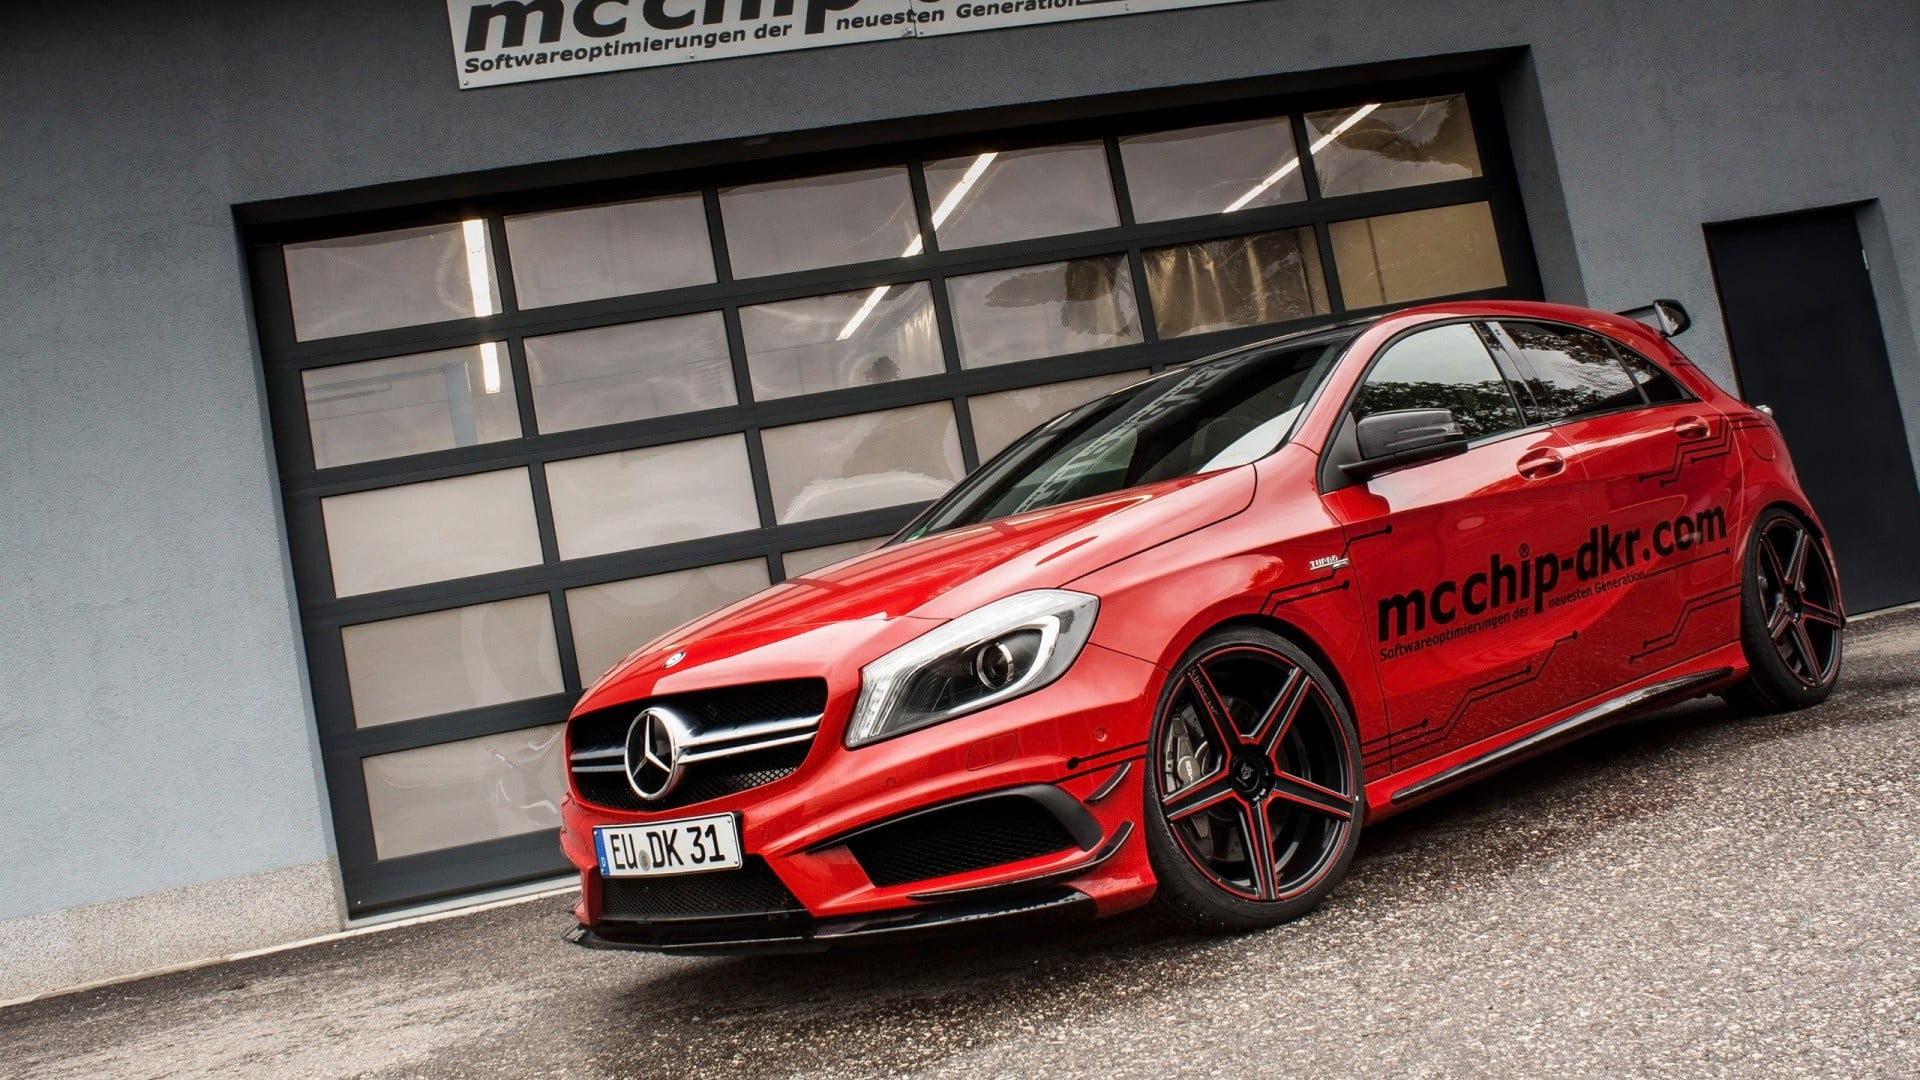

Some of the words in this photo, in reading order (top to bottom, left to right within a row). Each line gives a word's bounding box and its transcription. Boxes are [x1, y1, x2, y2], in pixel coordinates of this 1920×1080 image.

[464, 28, 746, 74] Softwareoptimierungen
[753, 22, 793, 40] der
[836, 9, 945, 31] neuesten
[956, 0, 1080, 19] Generation
[1379, 612, 1510, 662] Softwareoptimierungen
[1513, 605, 1531, 620] der
[1548, 586, 1593, 608] neuesten
[1594, 570, 1646, 594] Generation
[610, 833, 639, 870] EU
[646, 828, 684, 869] DK
[686, 824, 726, 864] 31
